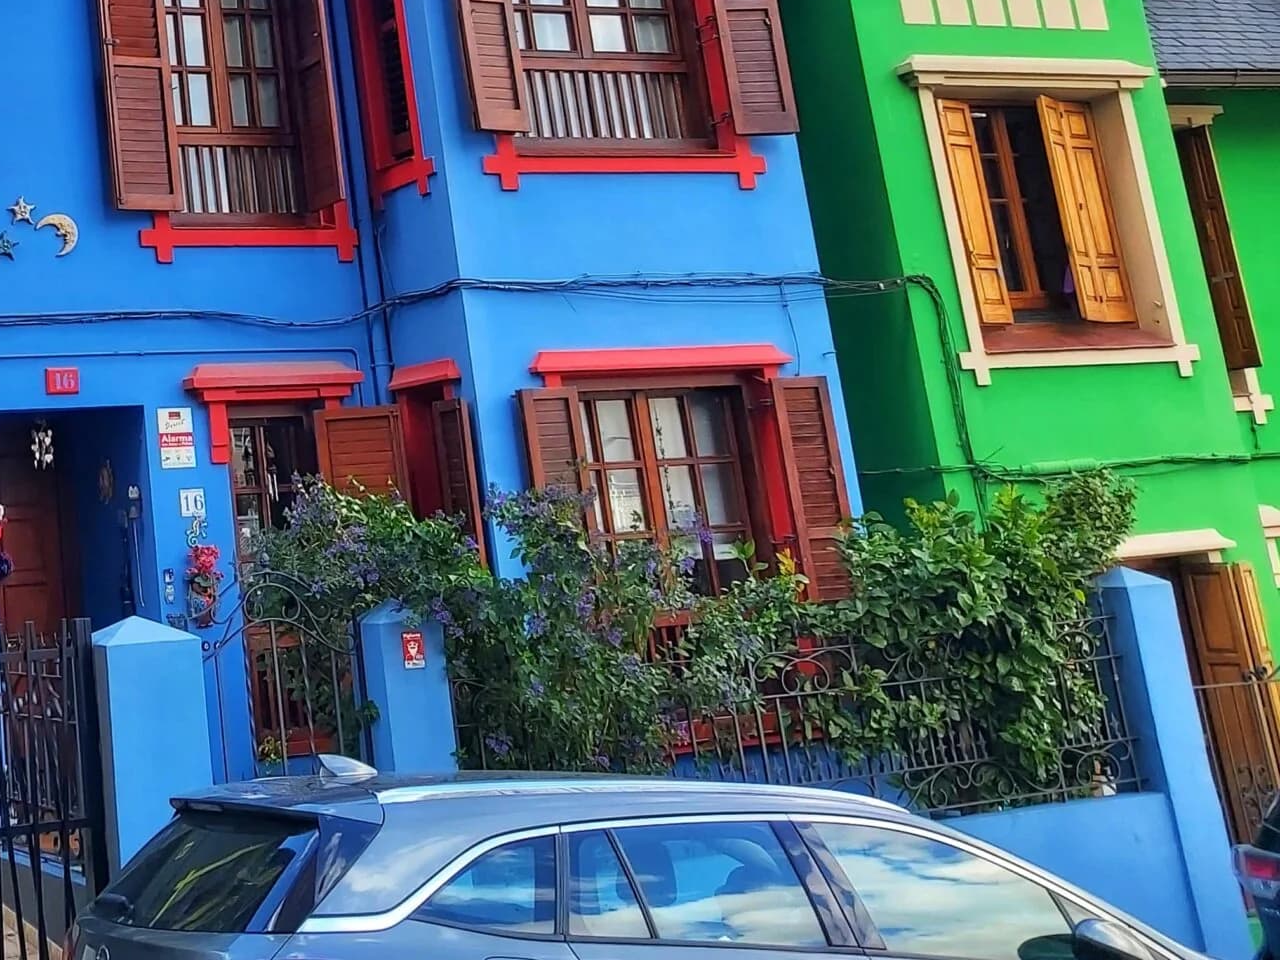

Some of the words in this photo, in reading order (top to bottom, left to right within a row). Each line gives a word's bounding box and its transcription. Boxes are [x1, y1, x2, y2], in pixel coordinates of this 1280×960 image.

[54, 372, 75, 389] 16
[161, 434, 193, 443] Alarma
[184, 494, 204, 512] 16
